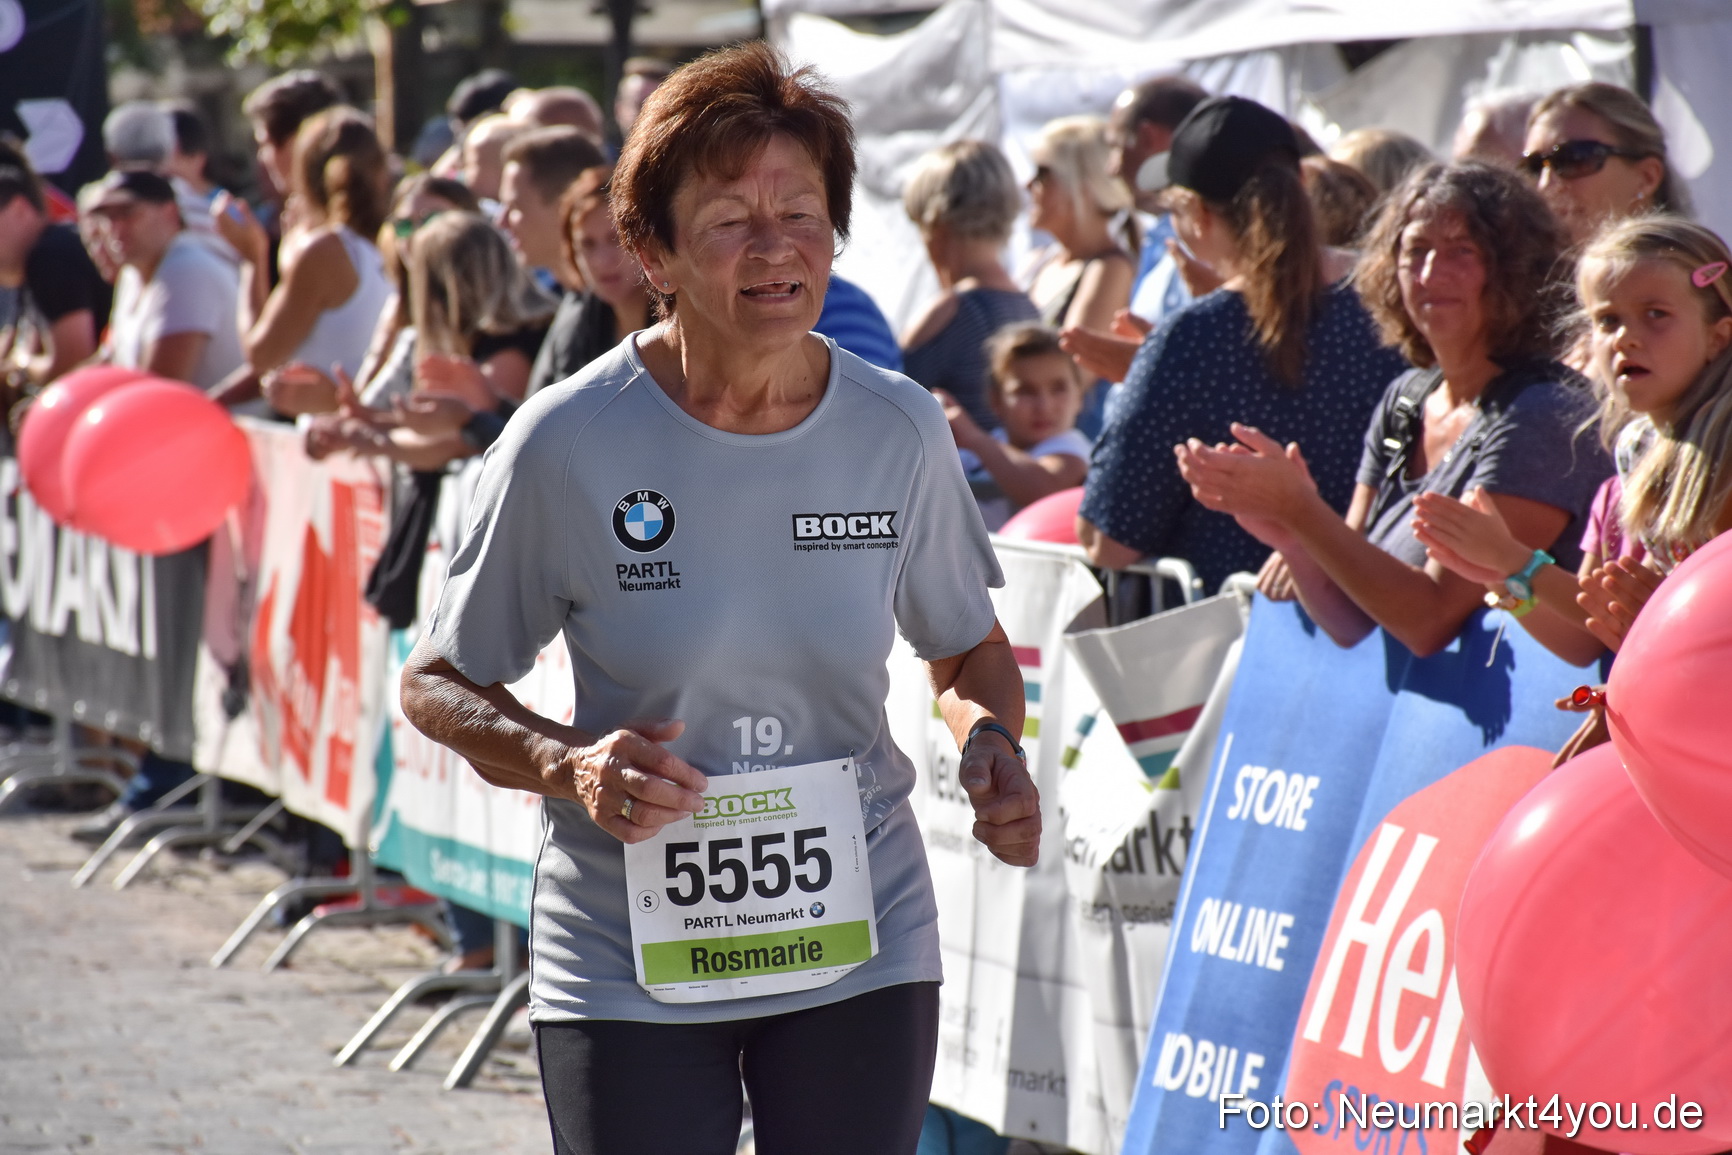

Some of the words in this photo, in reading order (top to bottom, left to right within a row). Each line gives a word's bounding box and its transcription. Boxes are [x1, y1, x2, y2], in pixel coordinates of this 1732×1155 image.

[617, 491, 670, 514] BMW
[792, 511, 899, 541] BOCK
[794, 542, 829, 552] inspired
[831, 542, 841, 552] by
[843, 541, 865, 551] smart
[866, 540, 899, 550] concepts
[616, 561, 680, 579] PARTL
[619, 577, 681, 592] Neumarkt
[732, 716, 794, 756] 19.
[693, 787, 796, 820] BOCK
[1227, 764, 1319, 832] STORE
[693, 821, 725, 829] inspired
[727, 818, 737, 826] by
[738, 816, 762, 825] smart
[763, 811, 798, 822] concepts
[665, 826, 833, 907] 5555
[643, 895, 652, 908] S
[684, 914, 733, 930] PARTL
[736, 907, 805, 925] Neumarkt
[1191, 897, 1294, 972] ONLINE
[690, 936, 823, 974] Rosmarie
